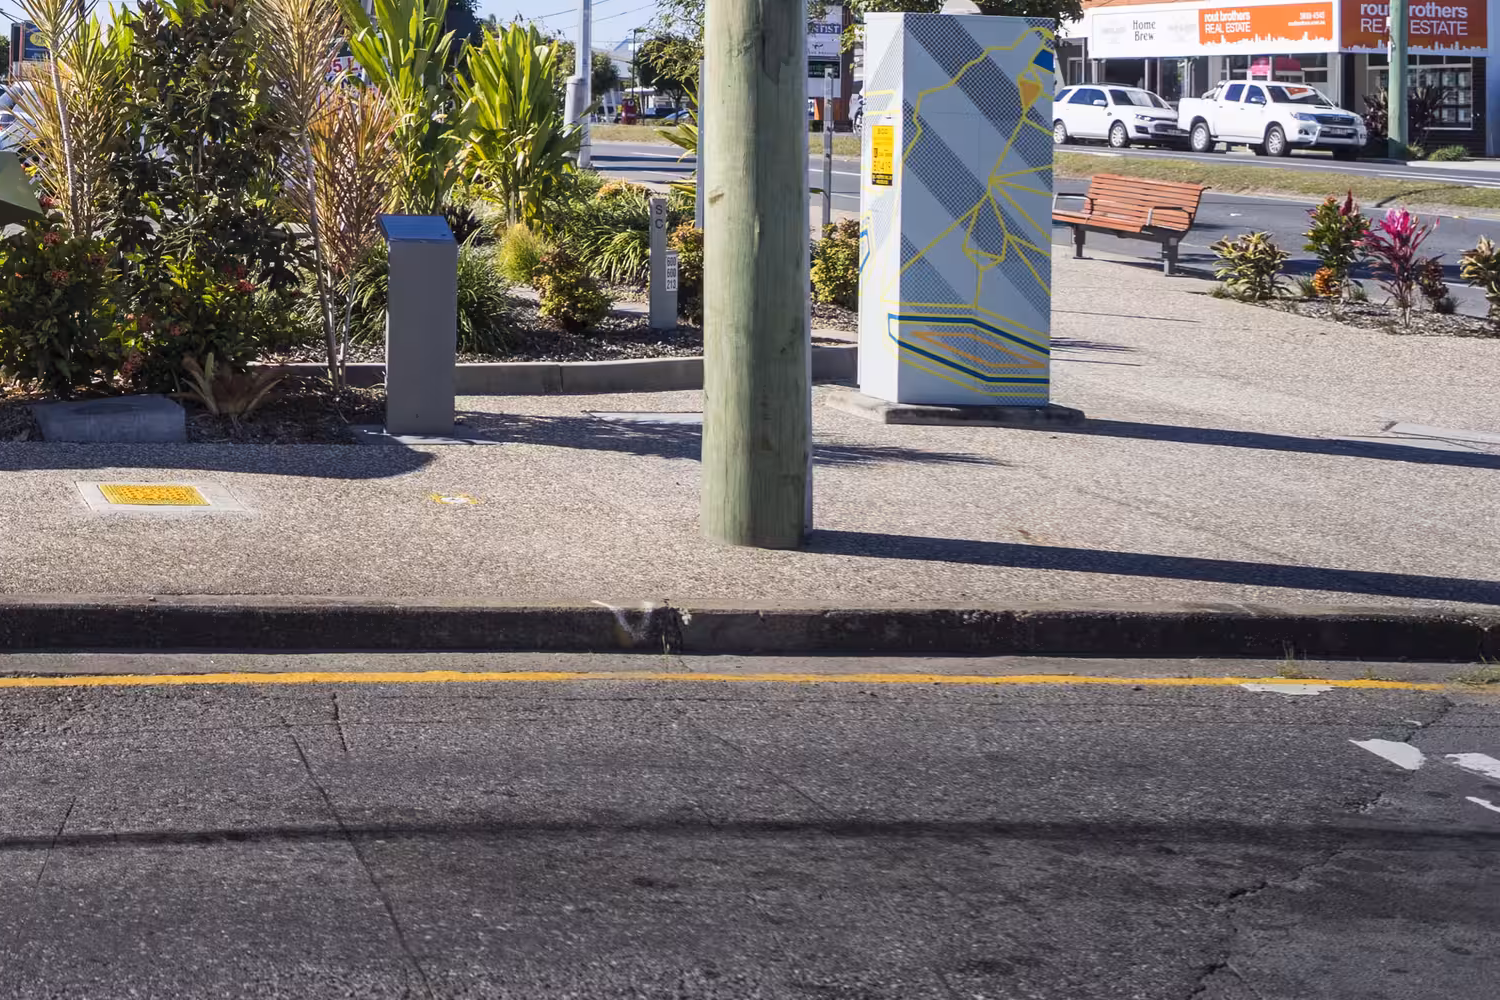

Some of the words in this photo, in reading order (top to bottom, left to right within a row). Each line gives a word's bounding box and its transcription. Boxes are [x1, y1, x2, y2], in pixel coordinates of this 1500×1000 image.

[1204, 11, 1219, 23] rout
[1220, 10, 1251, 22] brothers
[1360, 3, 1391, 16] rou
[1408, 1, 1469, 19] rothers
[1132, 19, 1156, 30] Home
[1204, 22, 1224, 34] REAL
[1225, 21, 1251, 33] ESTATE
[1409, 19, 1469, 36] ESTATE
[1134, 31, 1154, 41] Brew
[666, 279, 677, 290] 213
